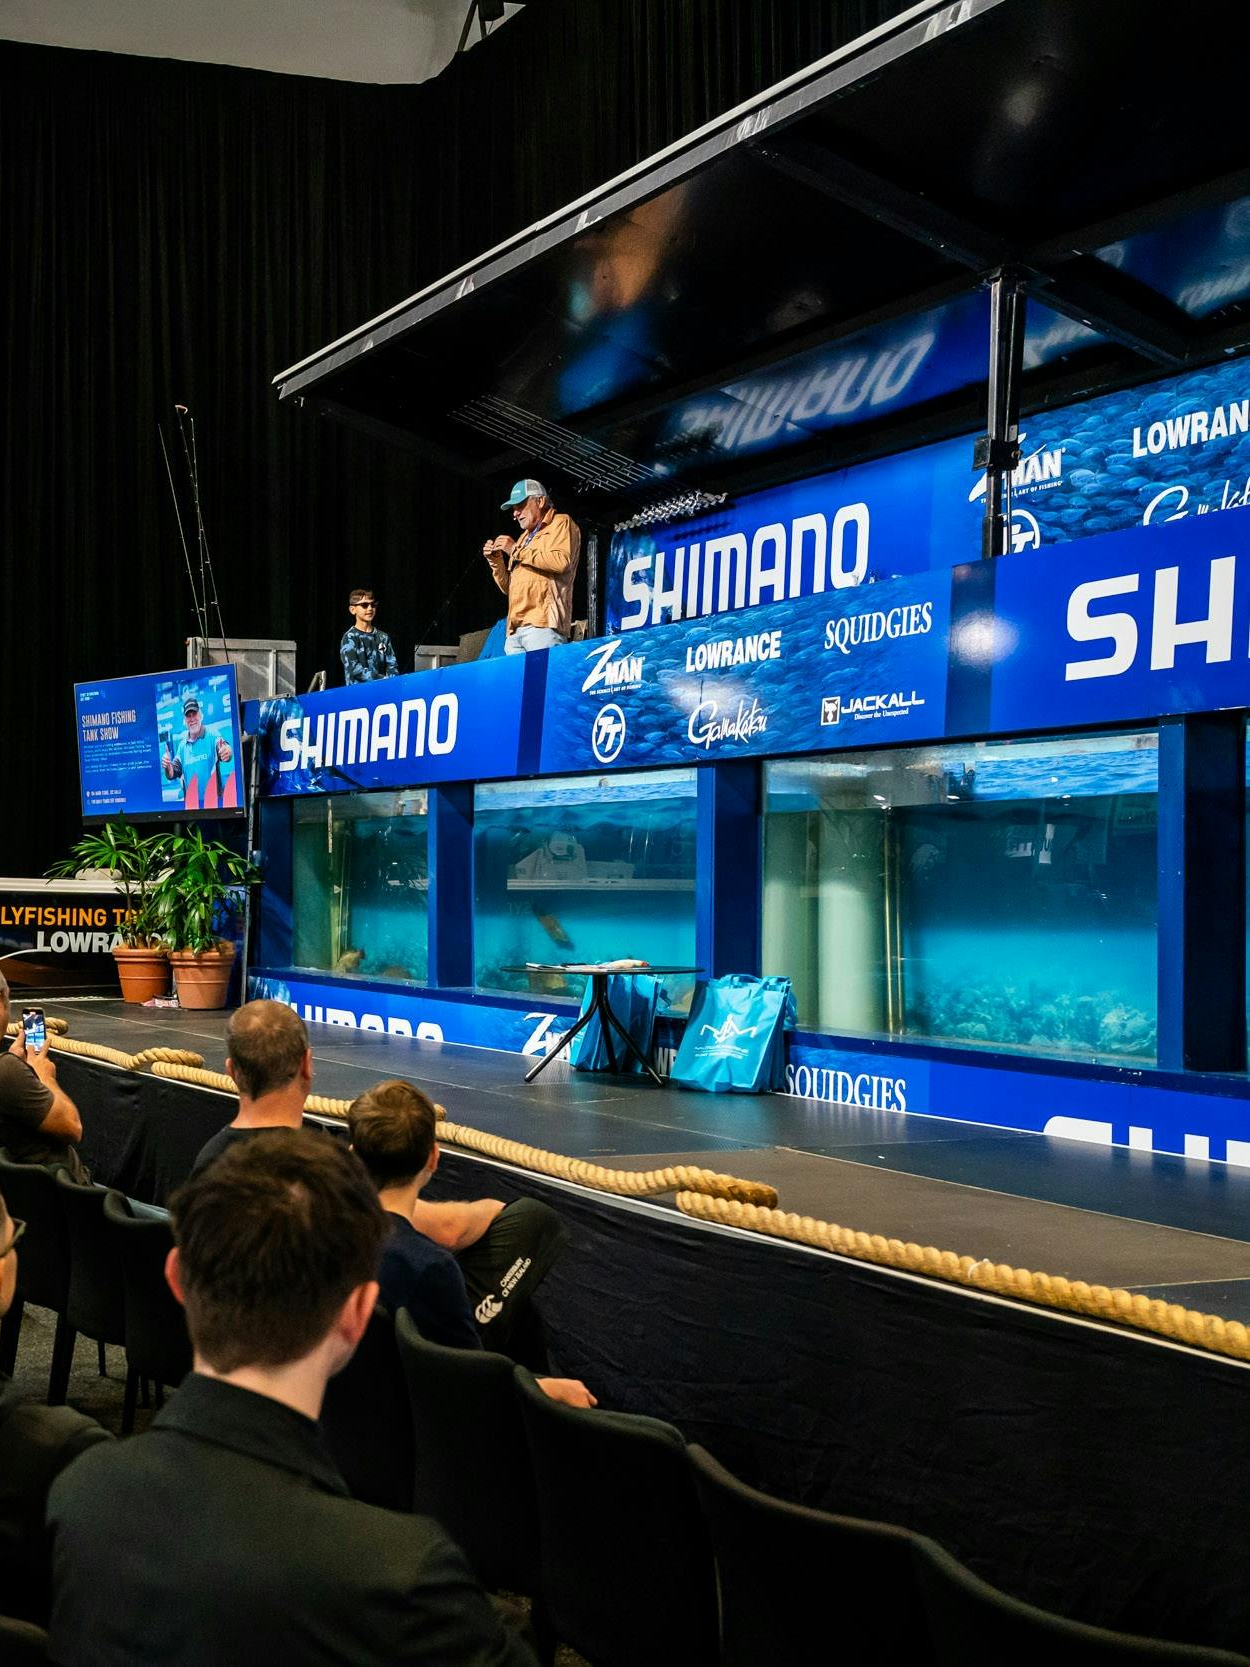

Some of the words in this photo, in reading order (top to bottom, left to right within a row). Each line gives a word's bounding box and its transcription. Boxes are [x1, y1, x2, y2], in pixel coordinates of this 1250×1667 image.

[969, 433, 1062, 502] MAN
[620, 502, 870, 631] SHIMANO
[685, 630, 782, 673] LOWRANCE
[824, 601, 933, 655] SQUIDGIES
[81, 713, 110, 728] SHIMANO
[111, 710, 136, 725] FISHING
[841, 691, 925, 714] JACKALL
[83, 728, 99, 741] TANK
[100, 726, 119, 740] SHOW
[278, 692, 459, 772] SHIMANO
